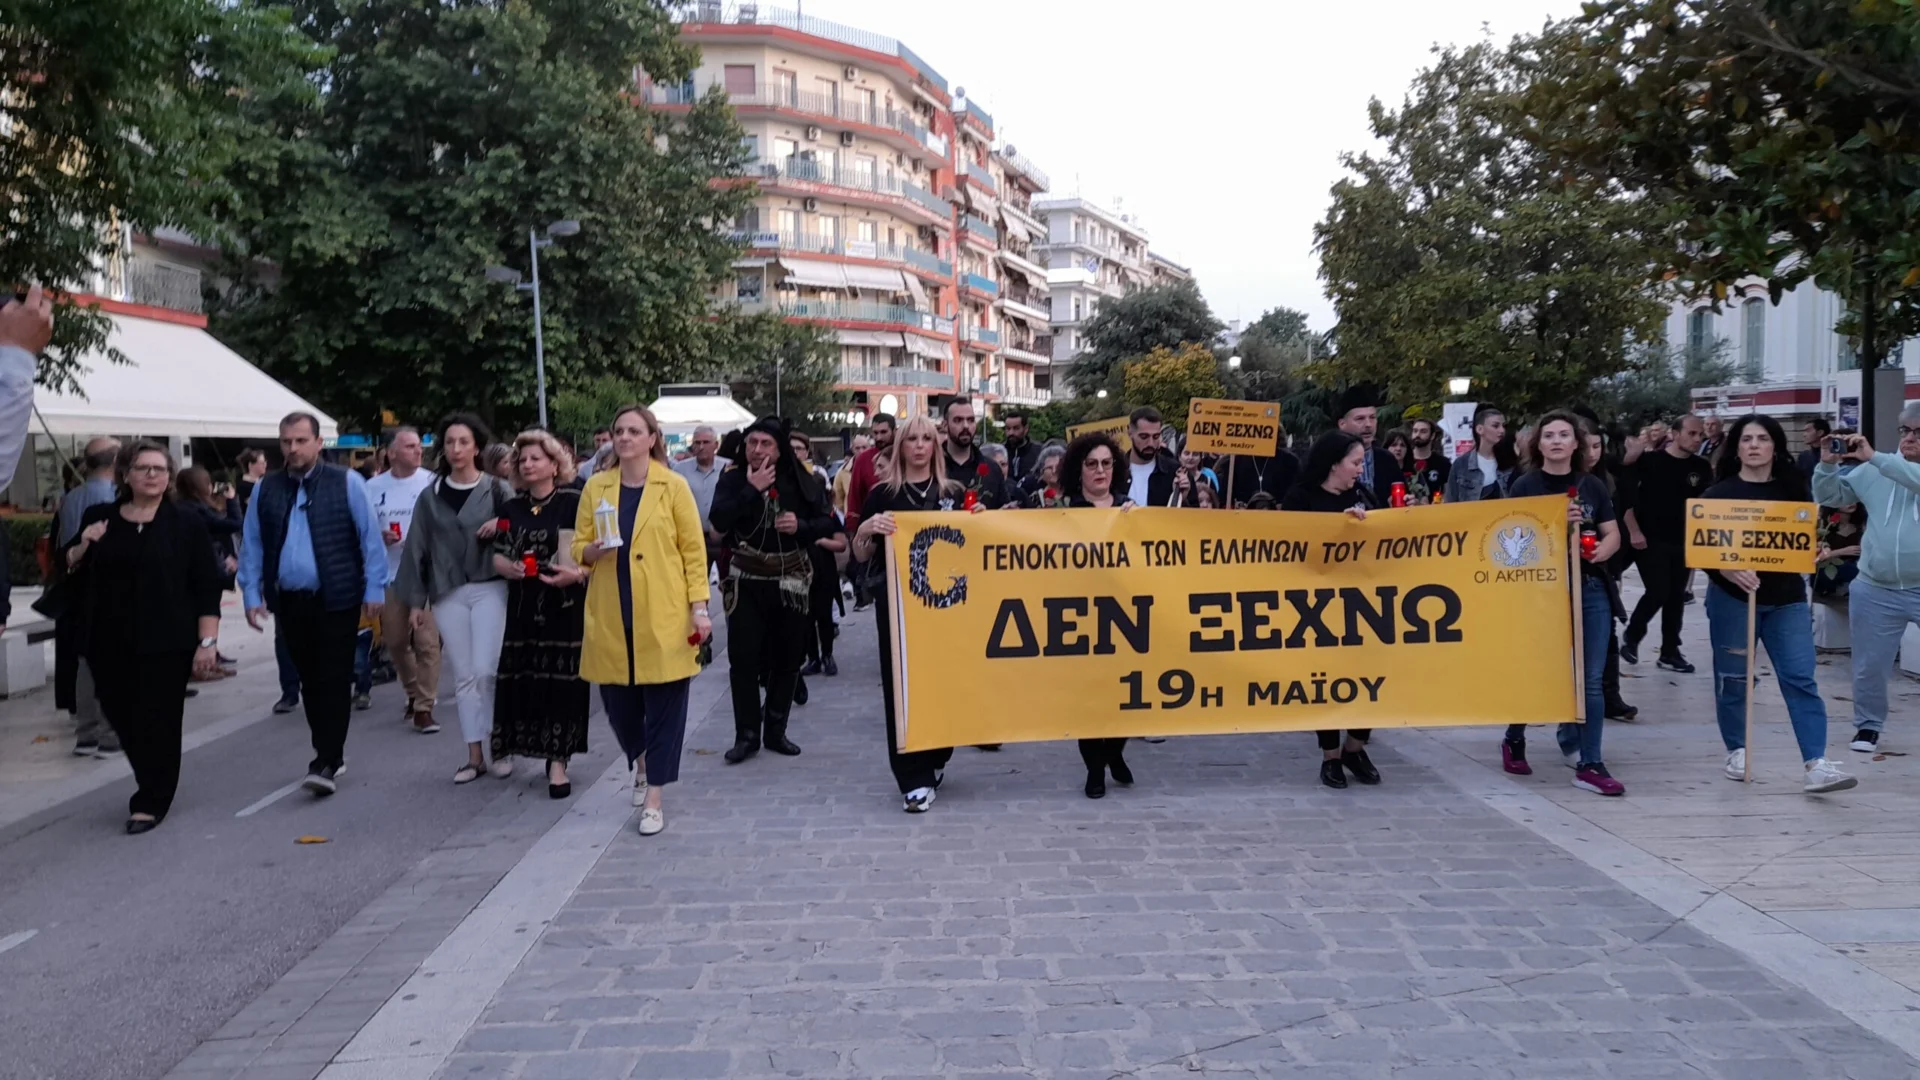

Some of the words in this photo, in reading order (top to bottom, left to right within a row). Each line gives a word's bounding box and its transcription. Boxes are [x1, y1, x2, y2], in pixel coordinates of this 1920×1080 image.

[1192, 421, 1221, 436] ΔΕΝ
[1226, 423, 1274, 439] ΞΕΧΝΩ
[983, 541, 1130, 571] ΓΕΝΟΚΤΟΝΙΑ
[1140, 539, 1187, 567] ΤΩΝ
[1199, 536, 1309, 566] ΕΛΛΗΝΩΝ
[1321, 540, 1368, 565] ΤΟΥ
[1375, 530, 1469, 561] ΠΟΝΤΟΥ
[1692, 528, 1734, 547] ΔΕΝ
[1742, 530, 1811, 551] ΞΕΧΝΩ
[1750, 555, 1785, 565] ΜΑΪΟΥ
[1474, 570, 1489, 584] ΟΙ
[1495, 568, 1557, 583] ΑΚΡΙΤΕΣ
[984, 595, 1154, 659] ΔΕΝ
[1188, 583, 1464, 656] ΞΕΧΝΩ
[1247, 672, 1387, 706] ΜΑΪΟΥ
